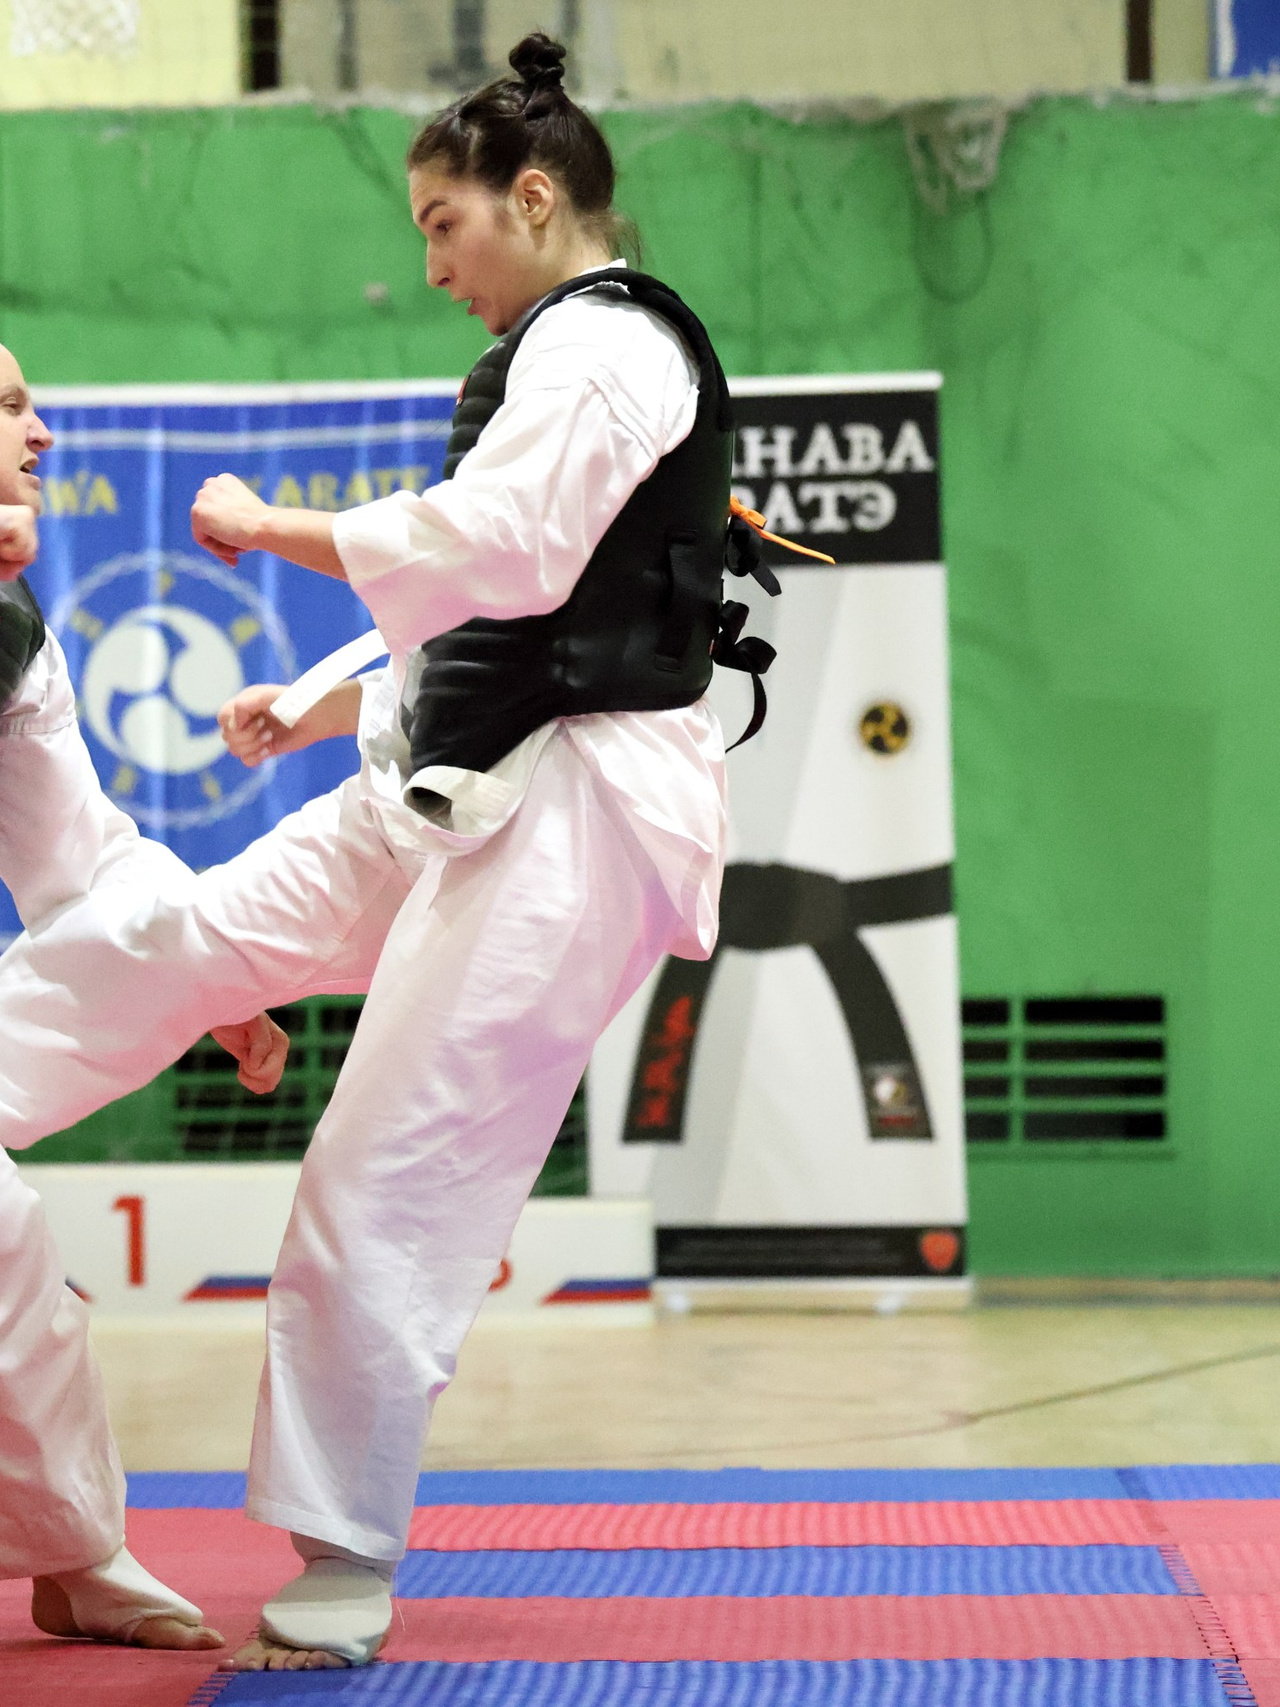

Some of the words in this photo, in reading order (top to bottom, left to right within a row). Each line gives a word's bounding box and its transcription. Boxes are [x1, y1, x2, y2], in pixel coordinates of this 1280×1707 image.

[732, 419, 934, 477] НАВА
[40, 471, 117, 516] WA
[241, 467, 429, 513] ARATE
[112, 1195, 145, 1286] 1
